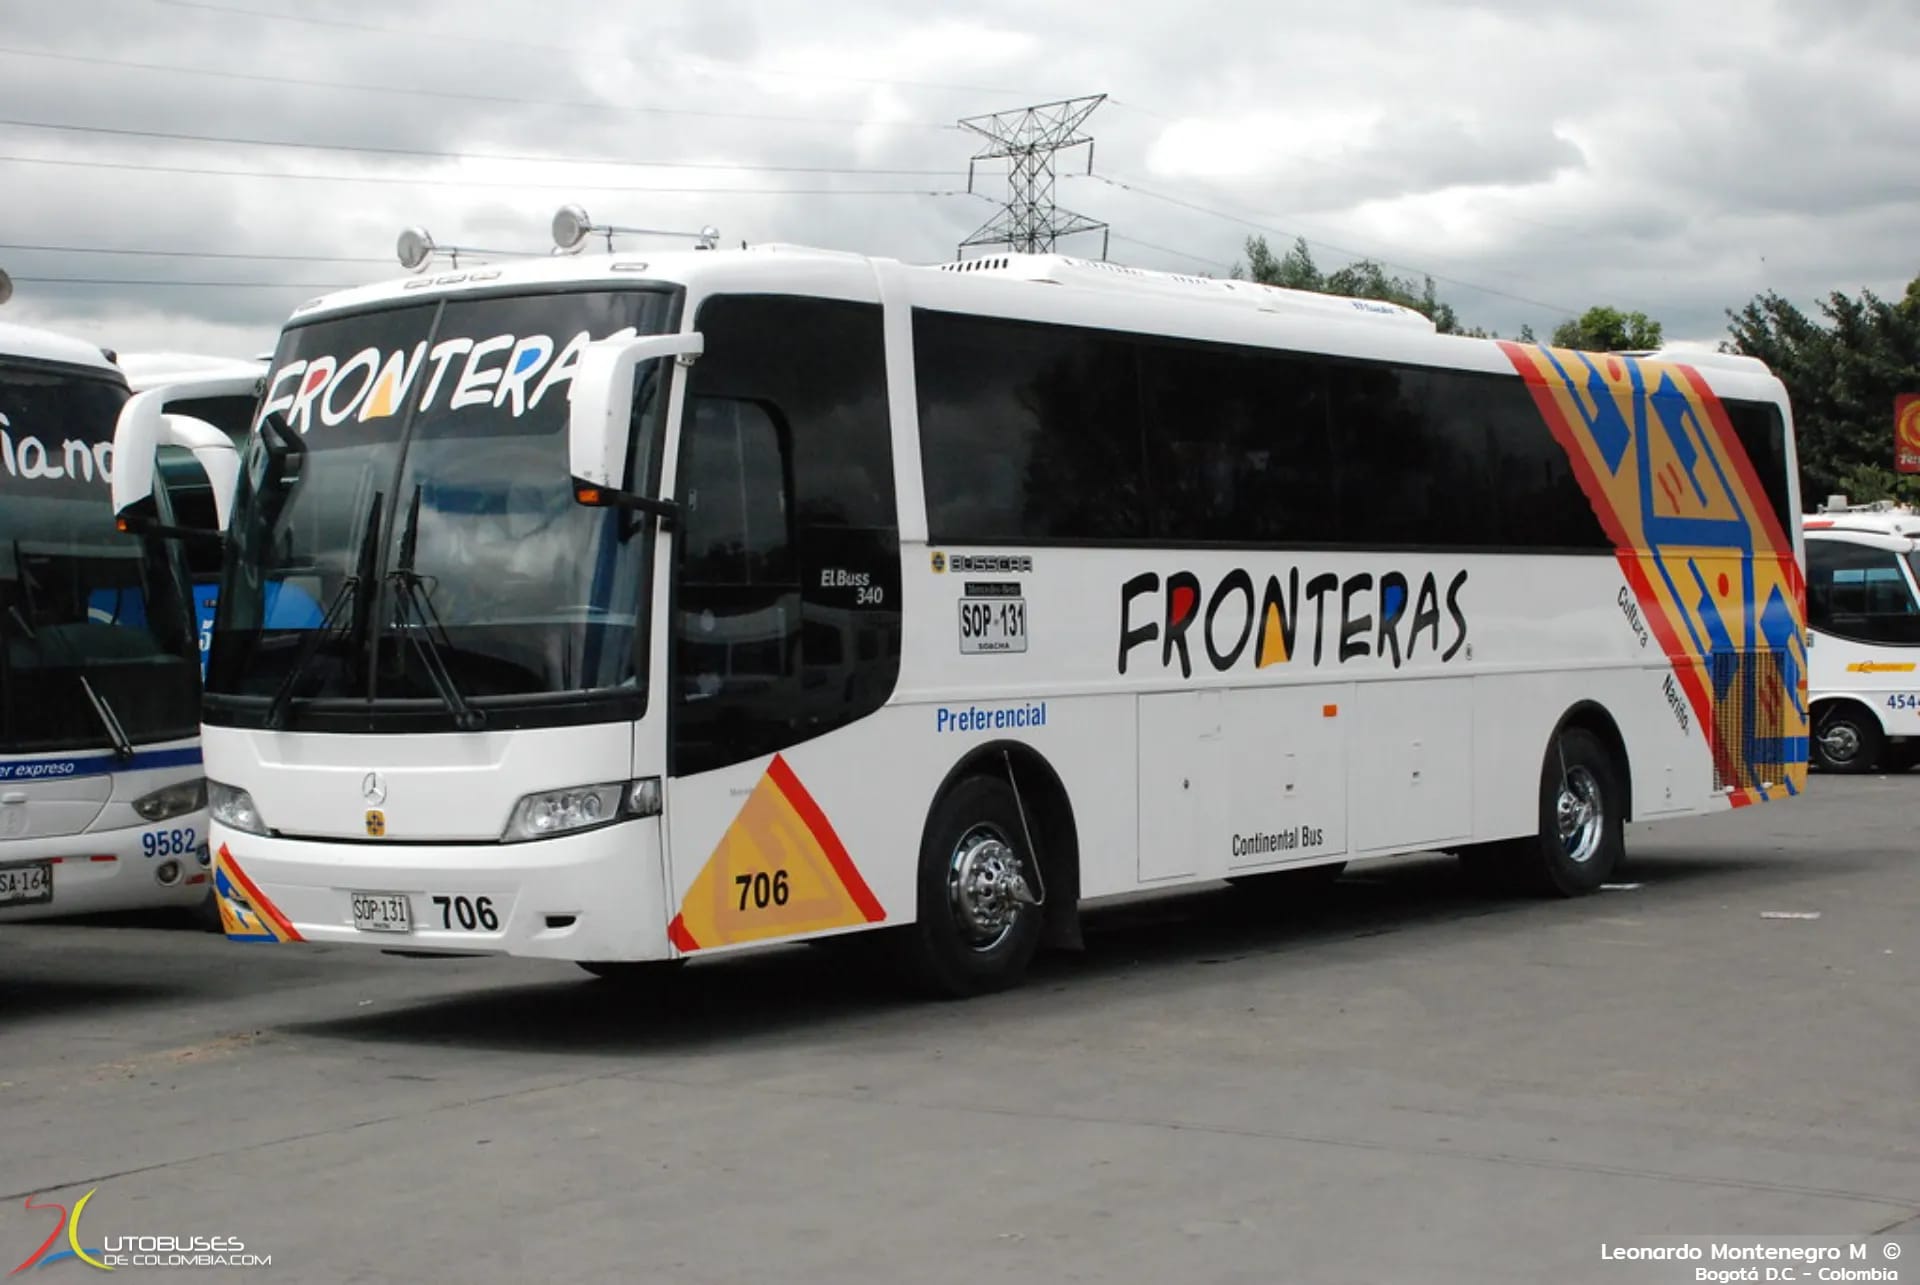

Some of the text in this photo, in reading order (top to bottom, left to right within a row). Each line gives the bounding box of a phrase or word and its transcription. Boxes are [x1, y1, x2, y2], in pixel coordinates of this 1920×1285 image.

[254, 326, 637, 434] FRONTERA
[857, 586, 884, 605] 340
[1117, 566, 1468, 679] FRONTERAS
[1617, 585, 1649, 649] Cultura
[937, 702, 1046, 733] Preferencial
[1886, 694, 1920, 710] 454
[15, 762, 75, 777] expreso
[143, 828, 196, 858] 9582
[1232, 825, 1324, 857] Continental Bus
[735, 869, 790, 911] 706
[432, 895, 499, 932] 706
